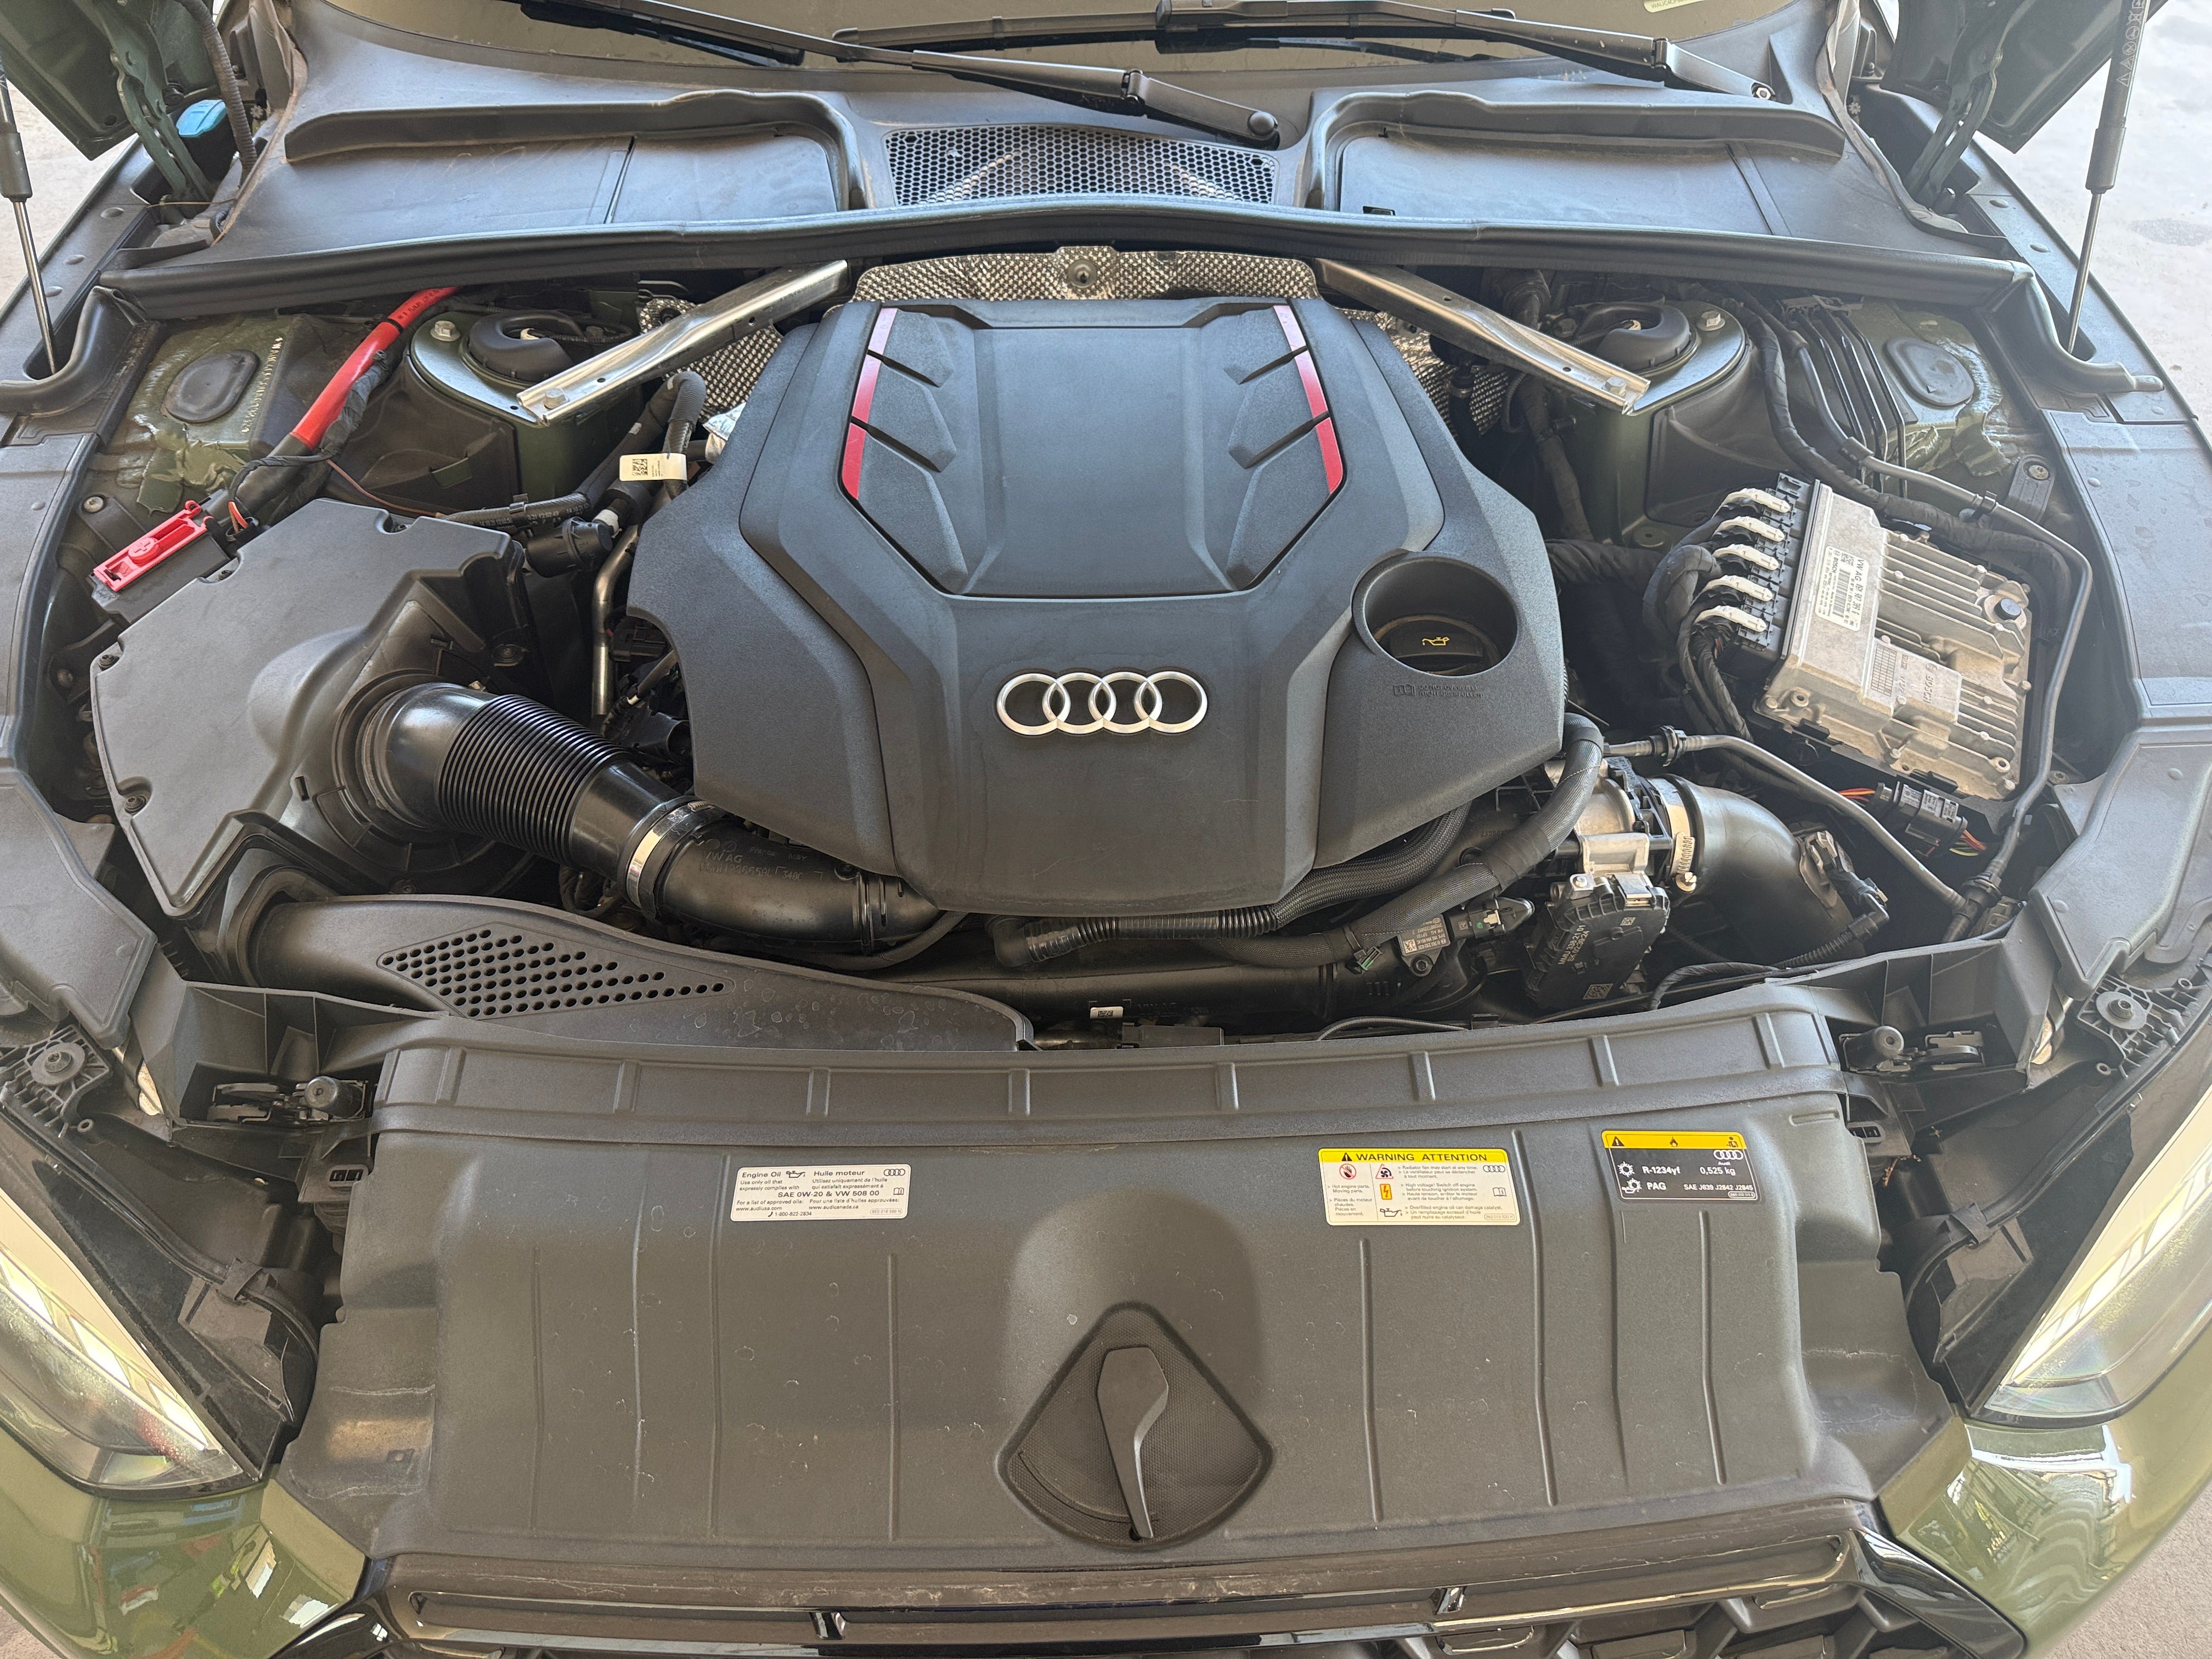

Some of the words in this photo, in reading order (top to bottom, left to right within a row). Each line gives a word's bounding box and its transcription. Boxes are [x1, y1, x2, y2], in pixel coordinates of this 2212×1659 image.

[1857, 559, 1864, 571] VW
[1855, 571, 1862, 582] AG
[1923, 675, 1933, 704] BOSCH
[725, 854, 743, 863] AG
[1642, 1166, 1680, 1175] R-1234yf
[1700, 1167, 1723, 1175] 0,525
[1725, 1167, 1736, 1176] kg
[1647, 1182, 1667, 1190] PAG
